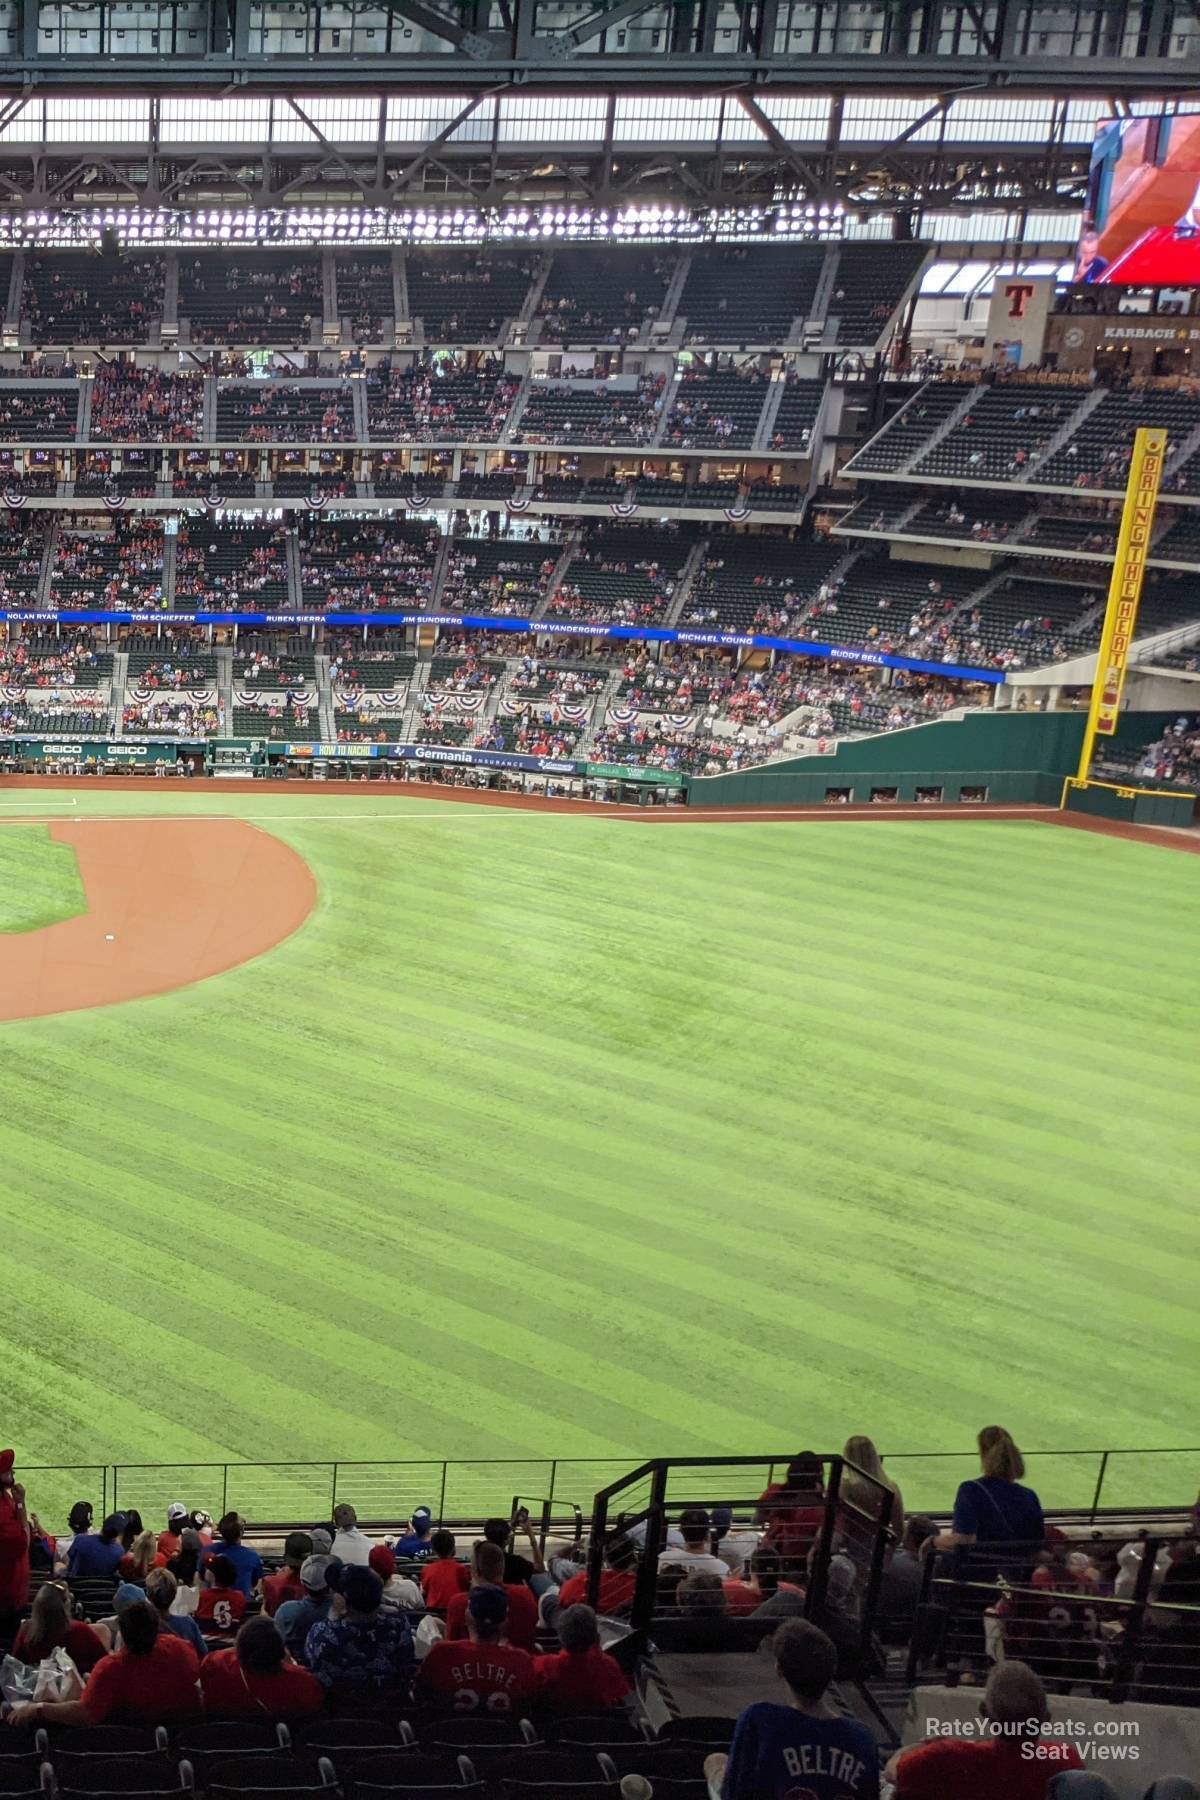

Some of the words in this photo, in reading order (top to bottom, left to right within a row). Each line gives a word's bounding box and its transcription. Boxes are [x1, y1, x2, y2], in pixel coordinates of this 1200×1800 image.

[1006, 285, 1033, 316] T
[1105, 328, 1176, 339] KARBACH
[1132, 456, 1157, 541] BRING
[1124, 548, 1143, 596] THE
[7, 612, 35, 620] NOLAN
[150, 614, 196, 622] SCHIEFFER
[296, 615, 326, 623] SIERRA
[401, 616, 415, 624] JIM
[417, 616, 463, 625] SUNDBERG
[529, 623, 548, 631] TOM
[549, 624, 611, 635] VANDERGRIFF
[1111, 602, 1133, 667] HEAT
[677, 633, 719, 643] MICHAEL
[720, 636, 753, 645] YOUNG
[830, 649, 860, 661] BUDDY
[861, 653, 884, 664] BELL
[42, 745, 82, 754] GEICO
[107, 746, 147, 755] GEICO
[319, 745, 337, 756] HOW
[337, 745, 346, 756] TO
[415, 748, 472, 763] Germania
[474, 758, 524, 767] INSURANCE
[213, 1600, 232, 1630] 6
[451, 1662, 517, 1689] BELTRE
[782, 1744, 866, 1791] BELTRE
